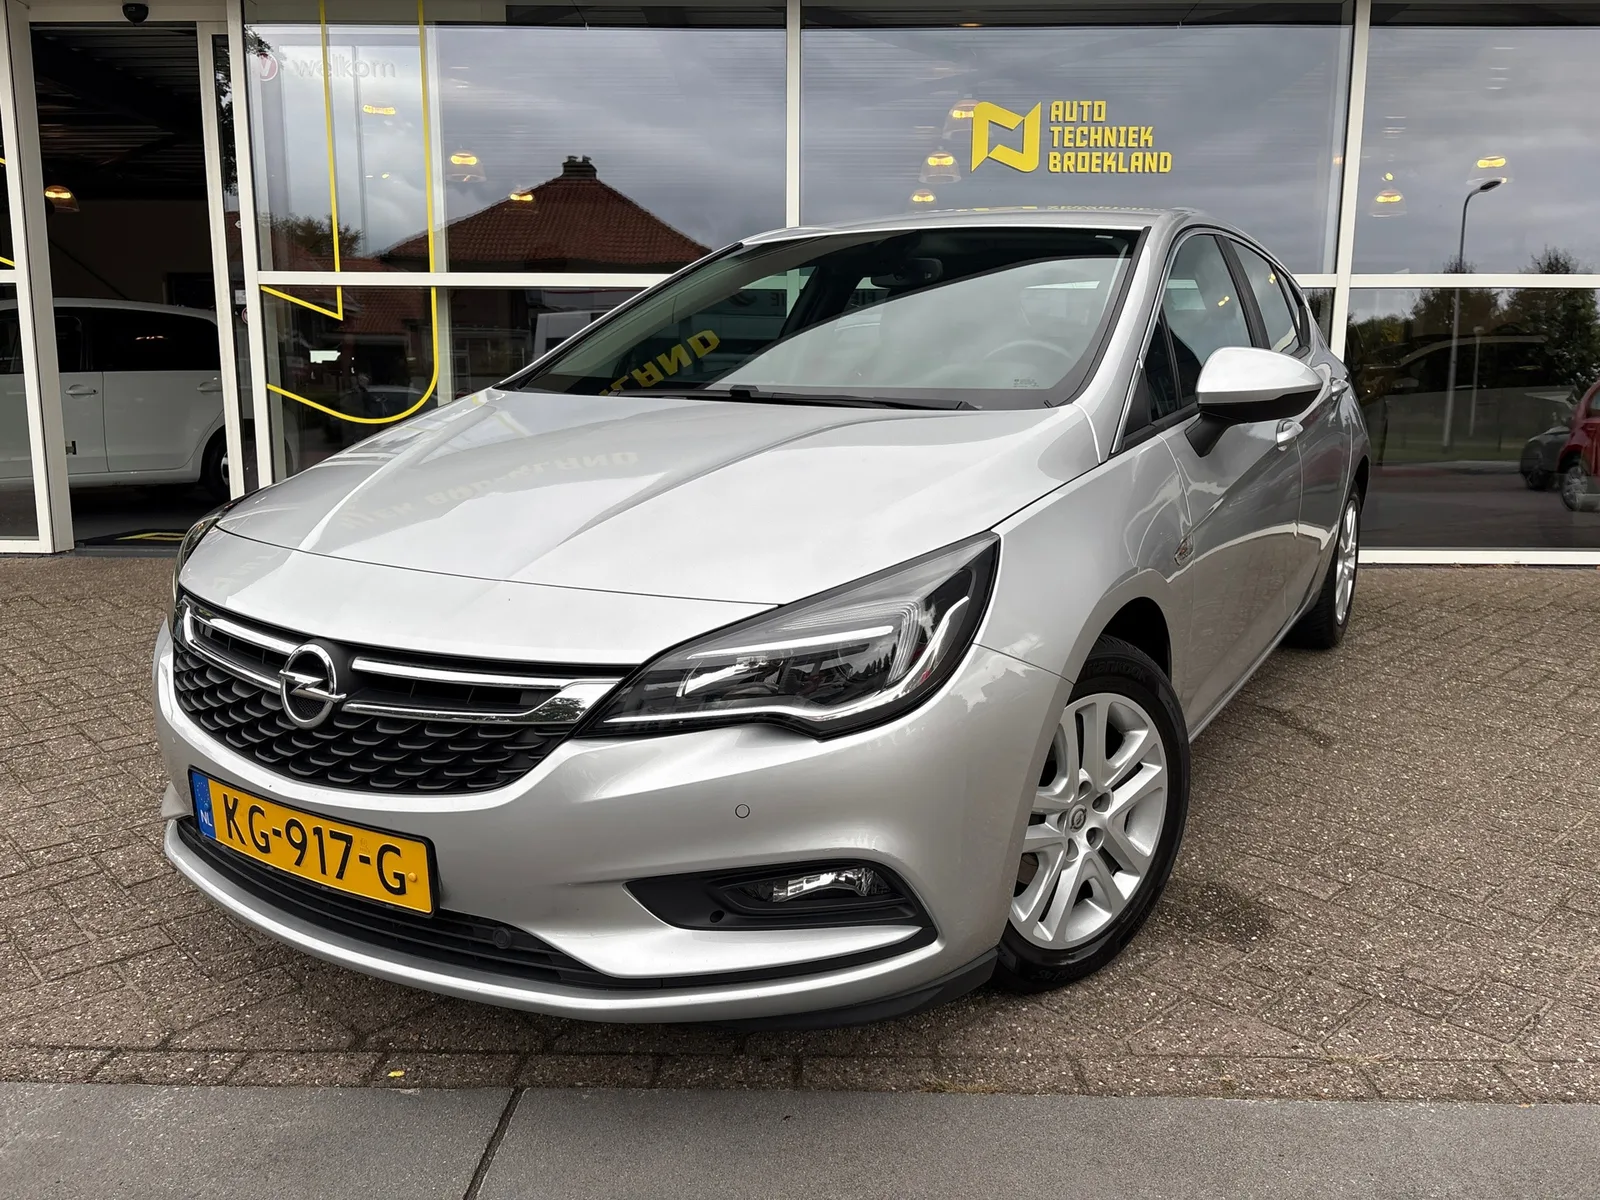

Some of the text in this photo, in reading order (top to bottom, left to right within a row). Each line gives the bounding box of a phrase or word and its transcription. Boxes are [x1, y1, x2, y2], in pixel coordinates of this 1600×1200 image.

[1050, 101, 1107, 122] AUTO
[1050, 126, 1154, 148] TECHNIEK
[1048, 151, 1173, 173] BROEKLAND
[200, 809, 213, 828] NL
[222, 793, 407, 896] KG-917-G
